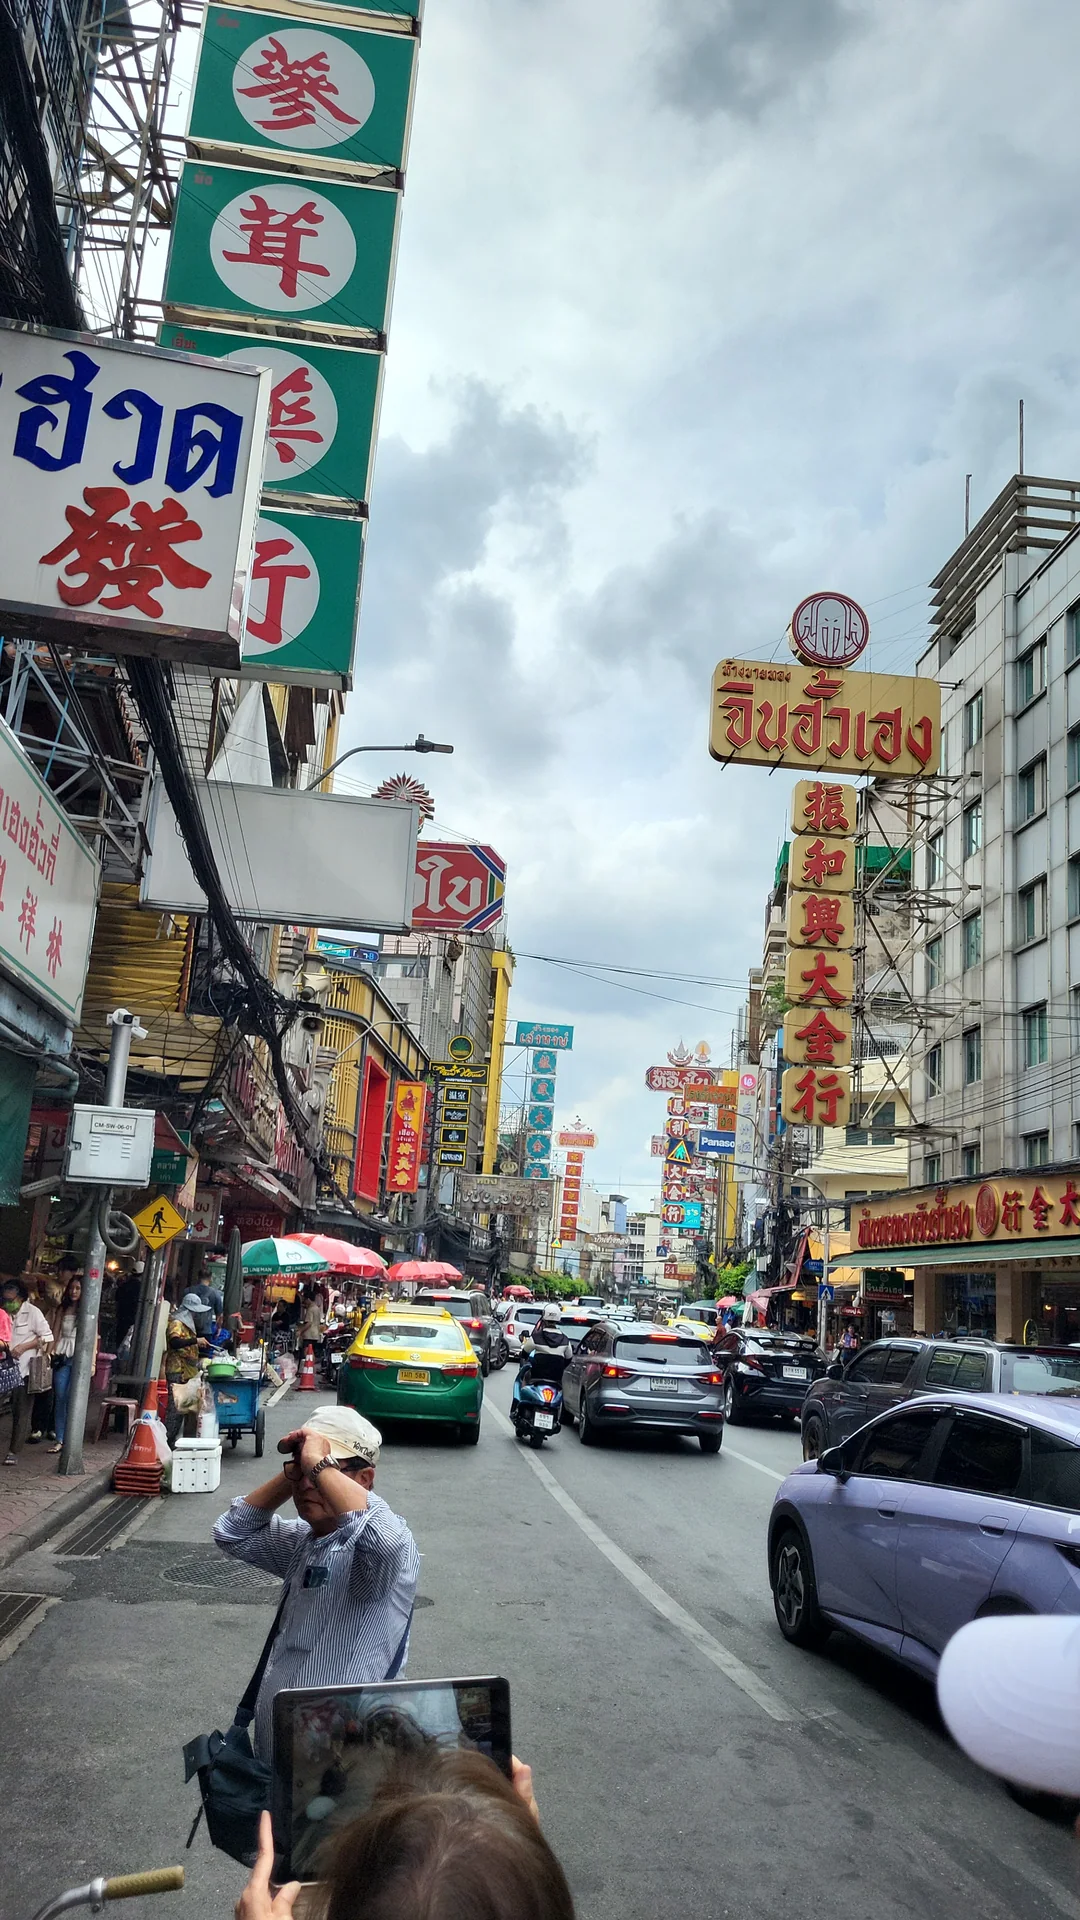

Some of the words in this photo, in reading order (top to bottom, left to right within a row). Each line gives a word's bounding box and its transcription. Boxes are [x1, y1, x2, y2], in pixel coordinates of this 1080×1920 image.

[0, 350, 243, 498] ฮวด
[38, 486, 213, 619] 發
[717, 669, 933, 766] จินฮั้วเฮง
[722, 661, 791, 683] ห้างขายทอง
[792, 781, 850, 1124] 振和興大金行
[94, 1122, 132, 1131] CM-SW-06-01
[667, 1098, 685, 1221] 馬利大金行
[665, 1265, 675, 1274] 24
